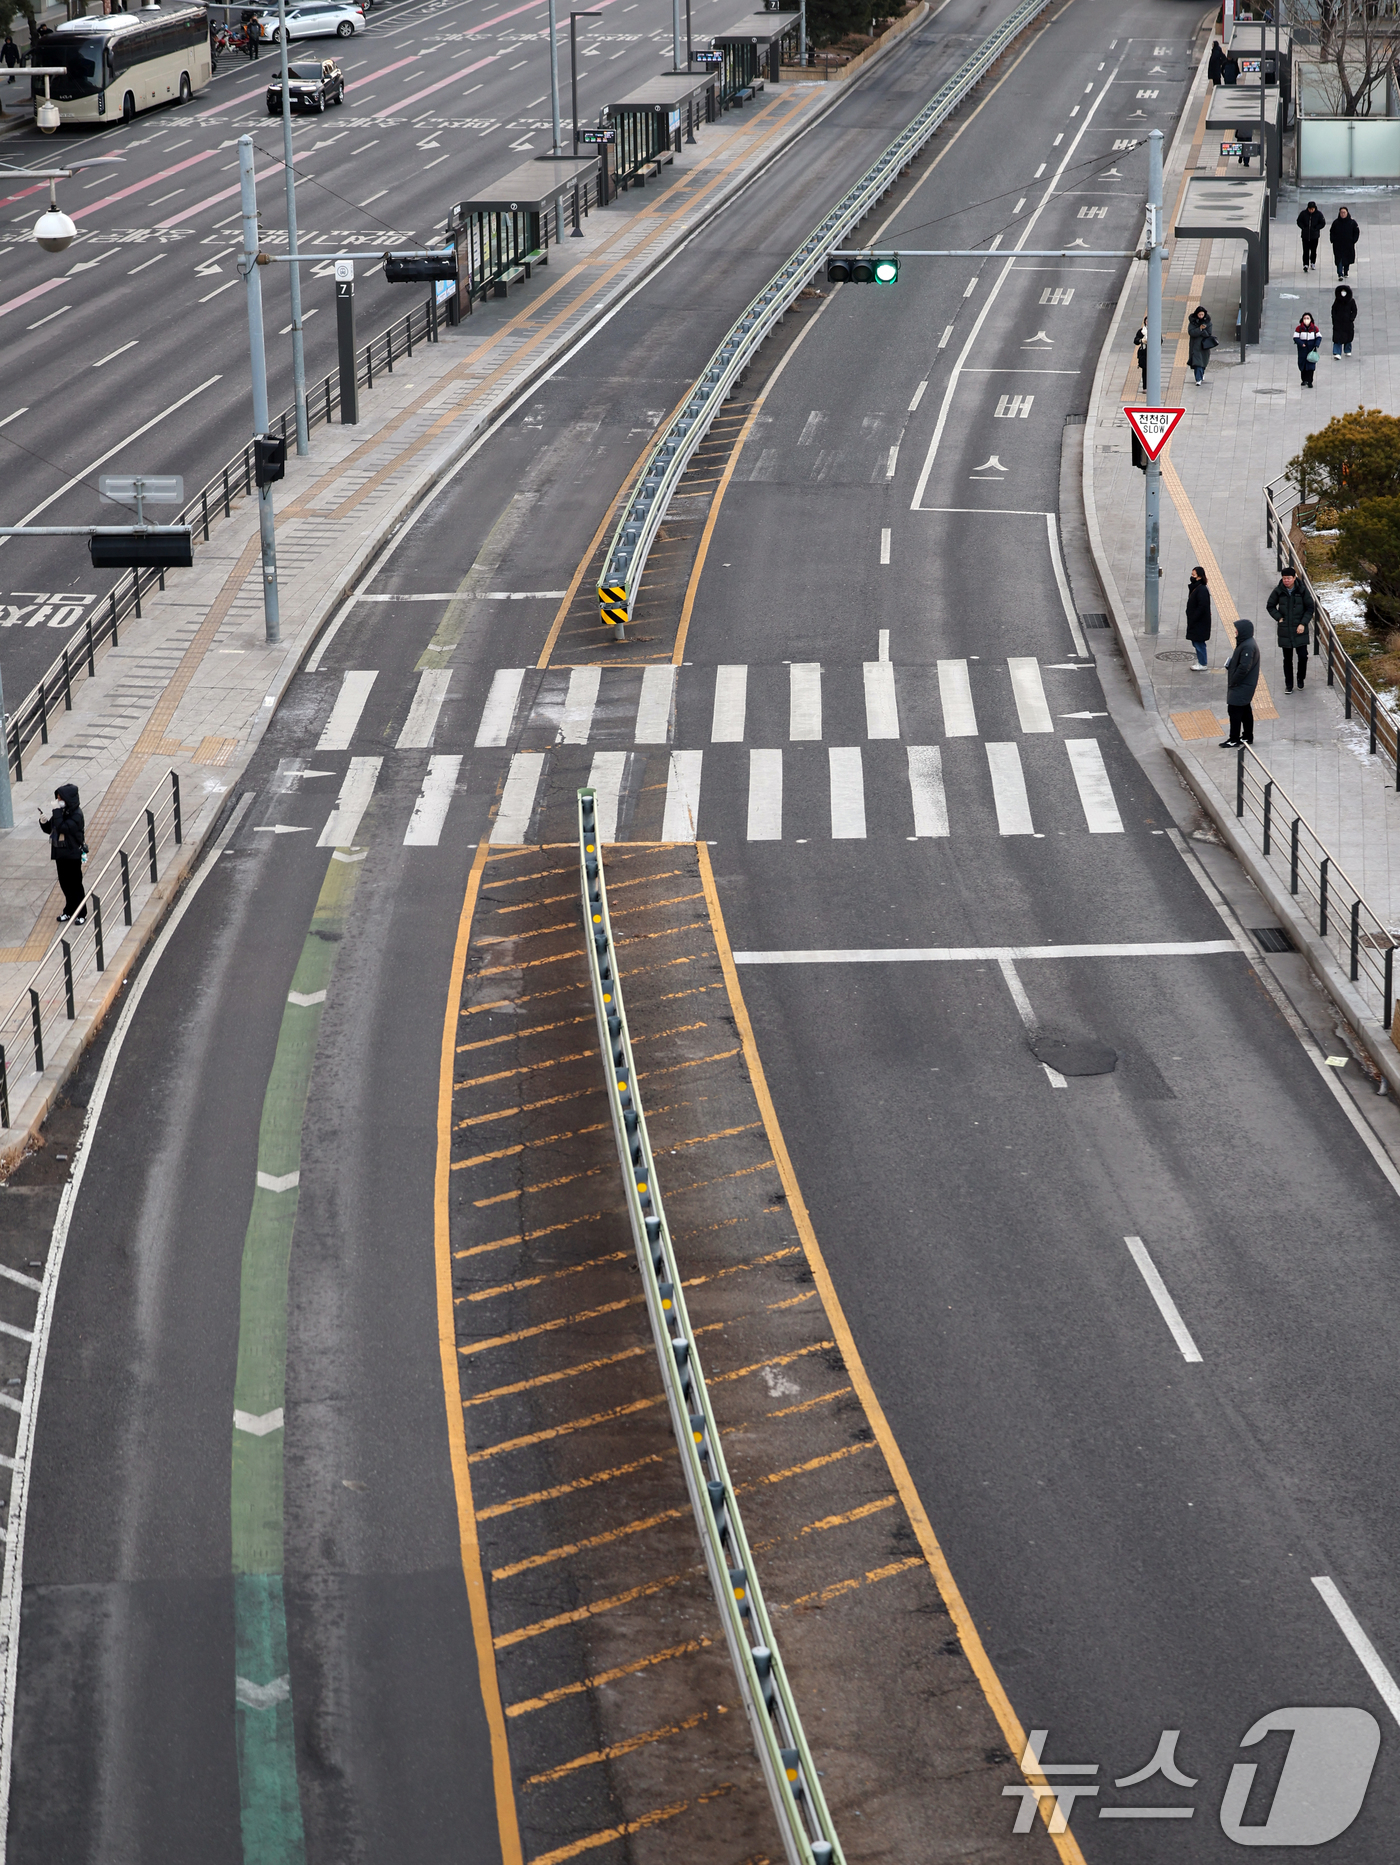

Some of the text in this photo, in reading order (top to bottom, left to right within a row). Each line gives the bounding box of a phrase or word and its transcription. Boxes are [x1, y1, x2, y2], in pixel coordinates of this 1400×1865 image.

[340, 284, 347, 294] 7
[1139, 414, 1169, 425] 천천히
[1143, 425, 1165, 433] SLOW
